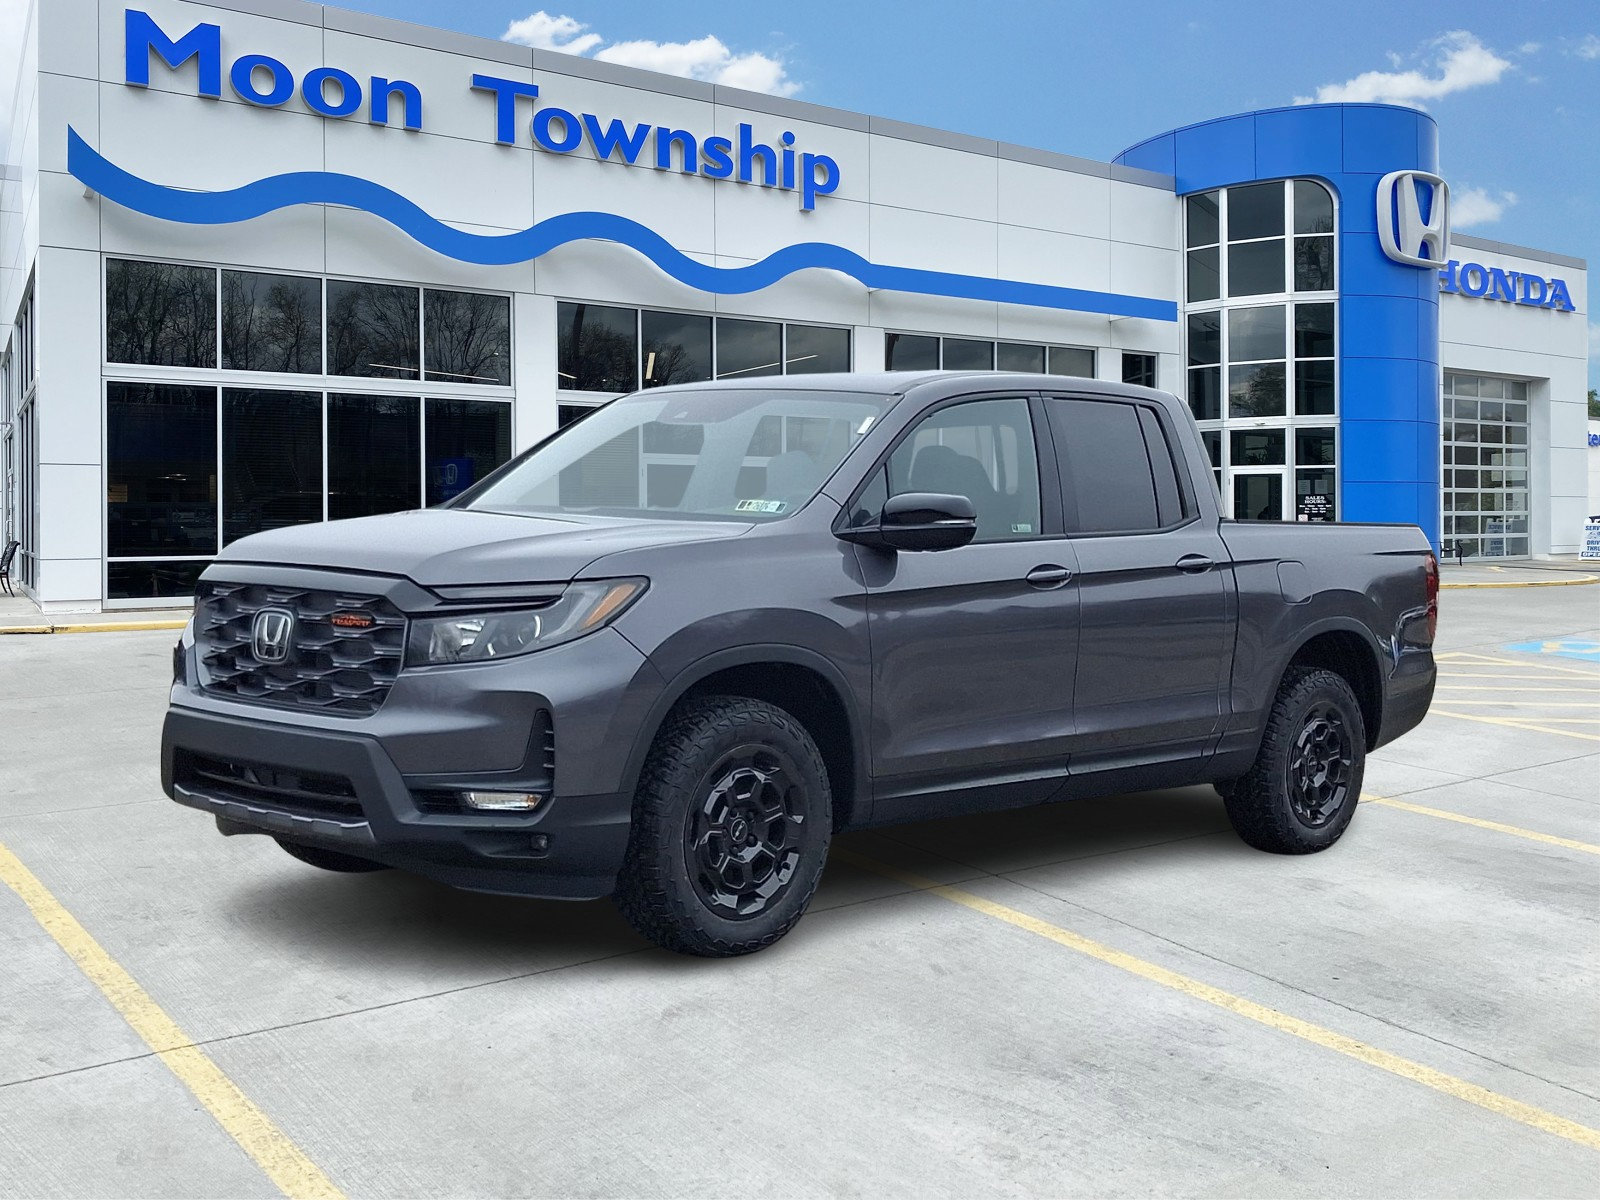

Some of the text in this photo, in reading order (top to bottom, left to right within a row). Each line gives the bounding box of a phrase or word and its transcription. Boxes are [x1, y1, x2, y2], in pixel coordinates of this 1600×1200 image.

[125, 9, 840, 212] Moon Township
[1439, 260, 1576, 312] HONDA
